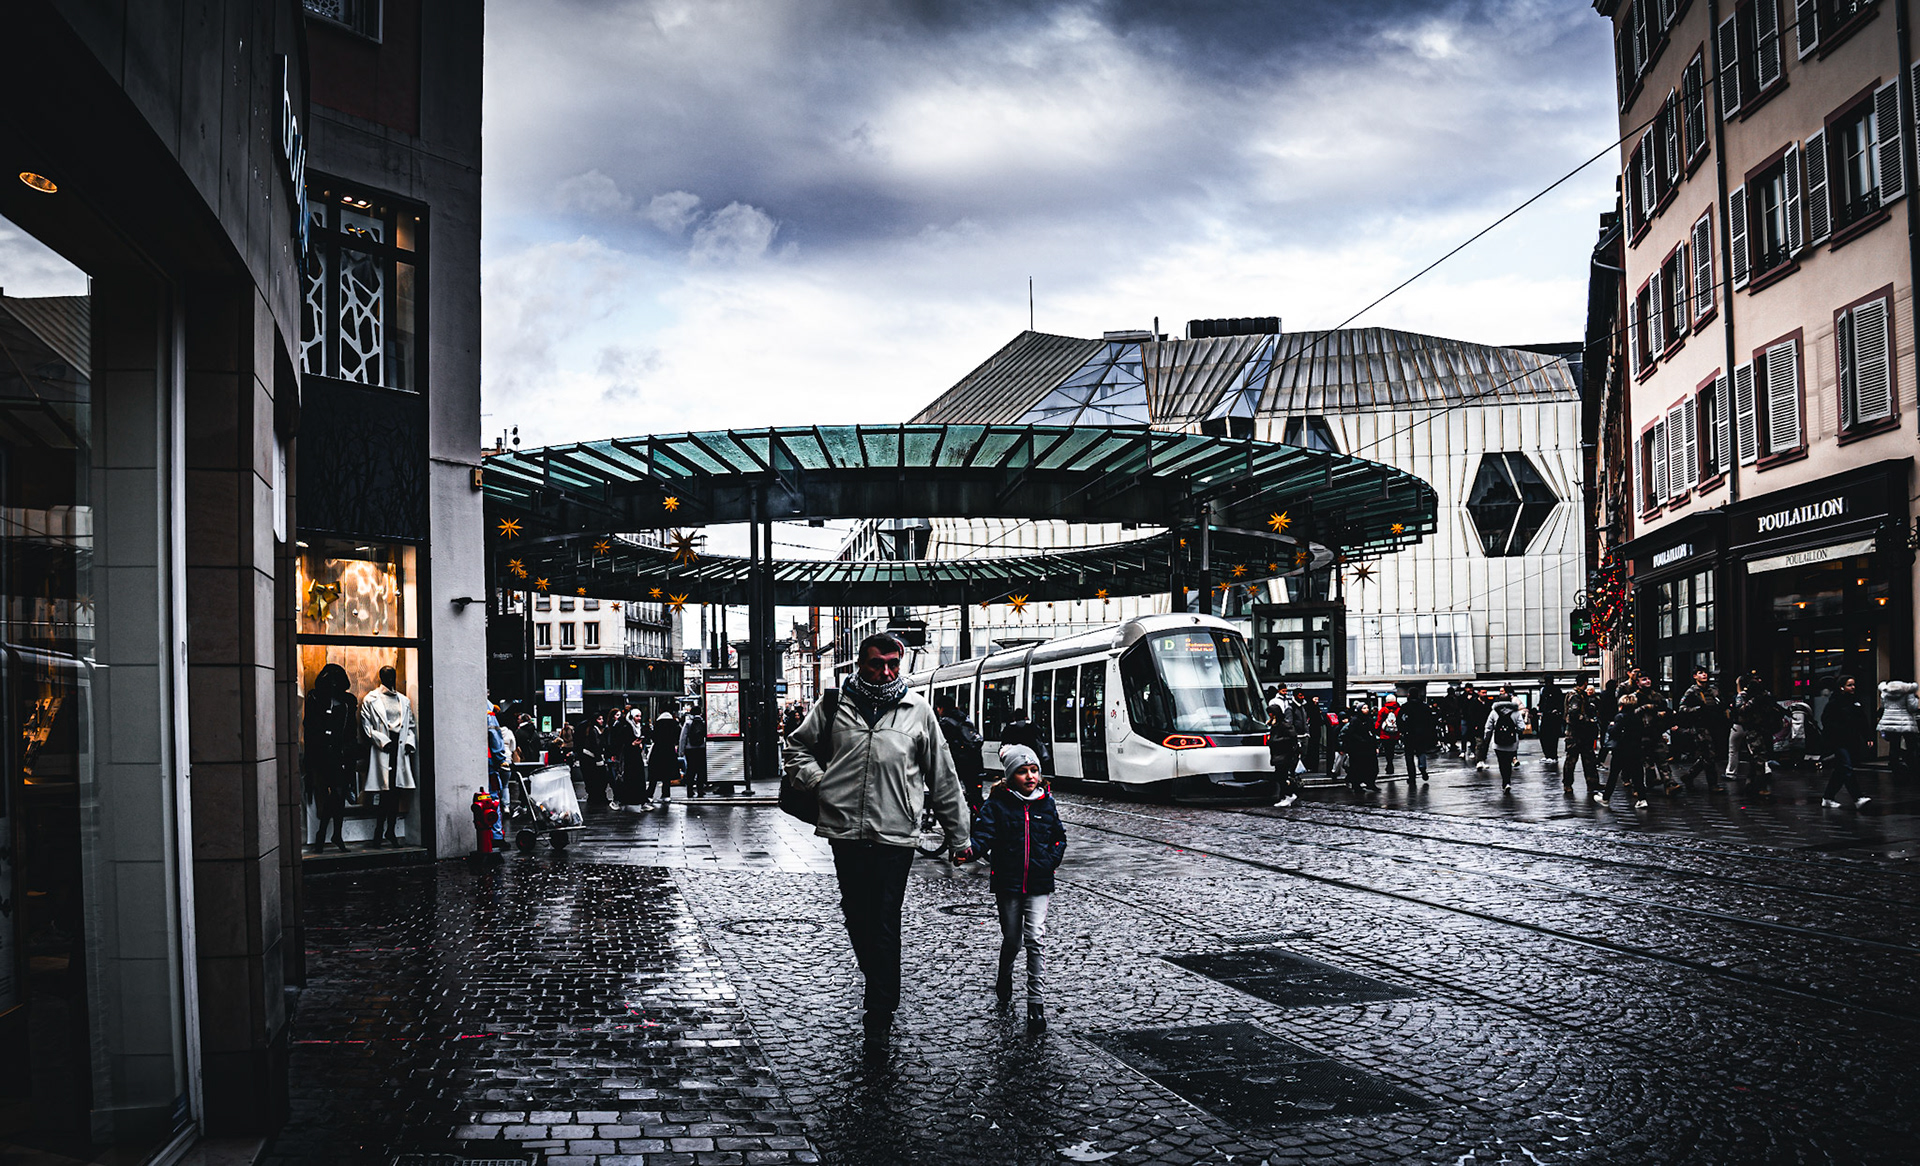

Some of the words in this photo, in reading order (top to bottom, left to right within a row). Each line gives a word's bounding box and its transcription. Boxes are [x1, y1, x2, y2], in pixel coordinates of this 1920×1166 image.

[1757, 496, 1844, 534] POULAILLON
[1785, 549, 1828, 566] POULAILLON
[1164, 639, 1175, 651] D
